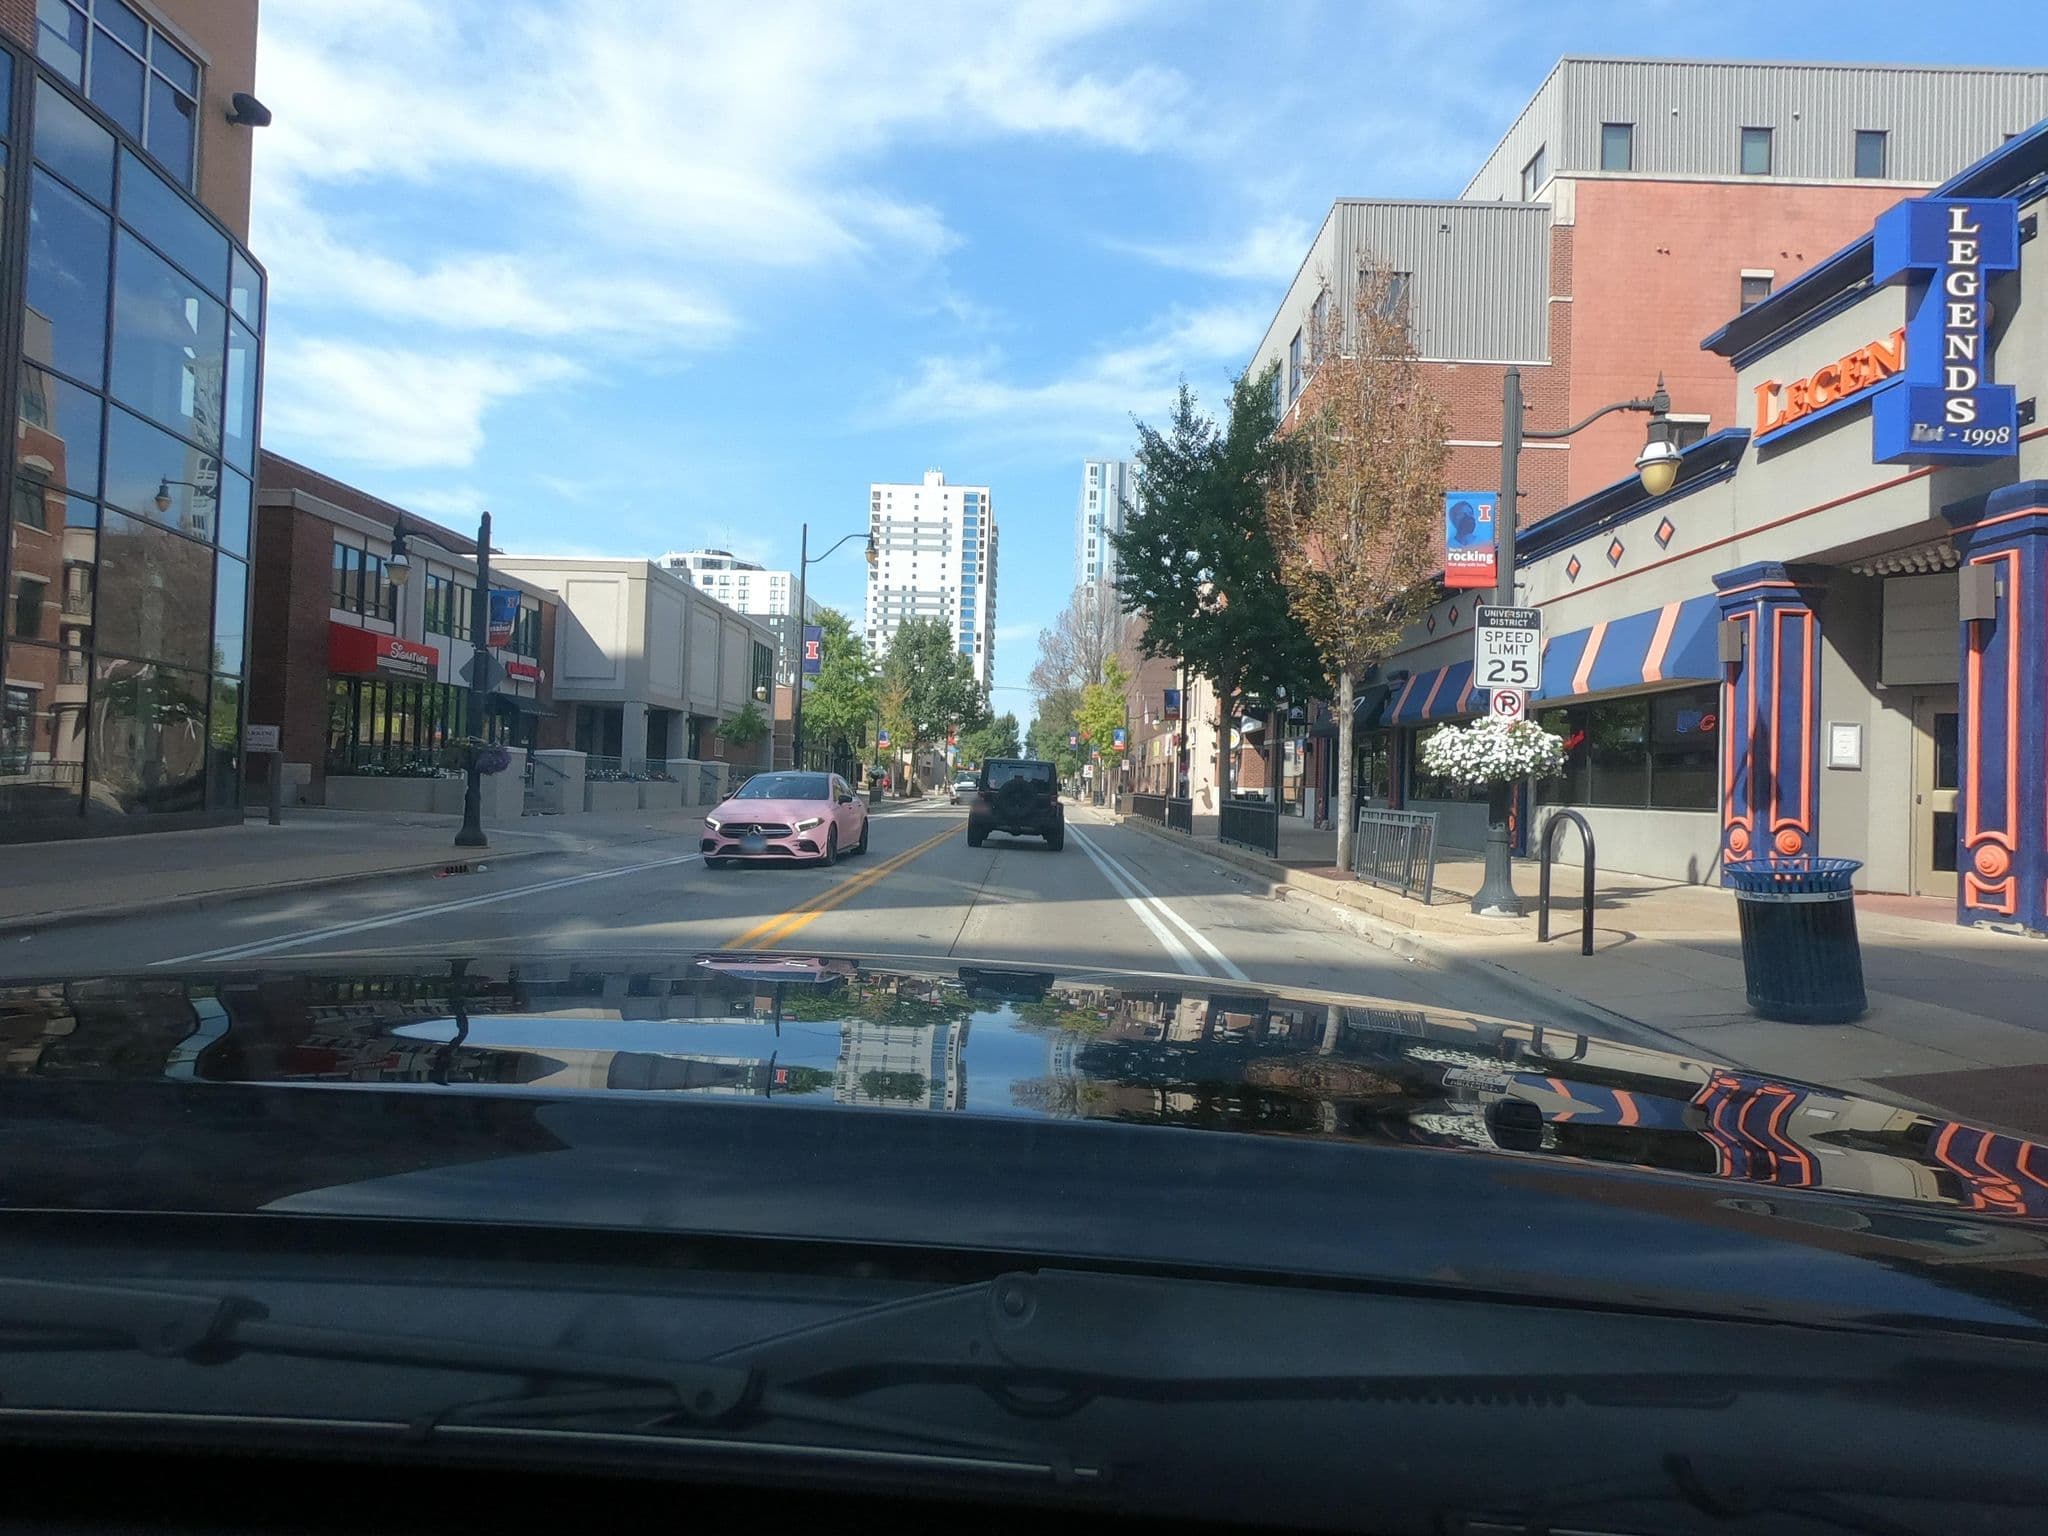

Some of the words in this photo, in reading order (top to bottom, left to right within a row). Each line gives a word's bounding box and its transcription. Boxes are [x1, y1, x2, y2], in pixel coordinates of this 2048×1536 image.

[1945, 207, 1980, 424] LEGENDS
[1960, 426, 2010, 447] 1998
[1447, 550, 1494, 564] rocking
[1484, 609, 1535, 619] UNIVERSITY
[1490, 619, 1529, 627] DISTRICT
[1484, 631, 1534, 643] SPEED
[1489, 643, 1529, 655] LIMIT
[1487, 660, 1529, 684] 25
